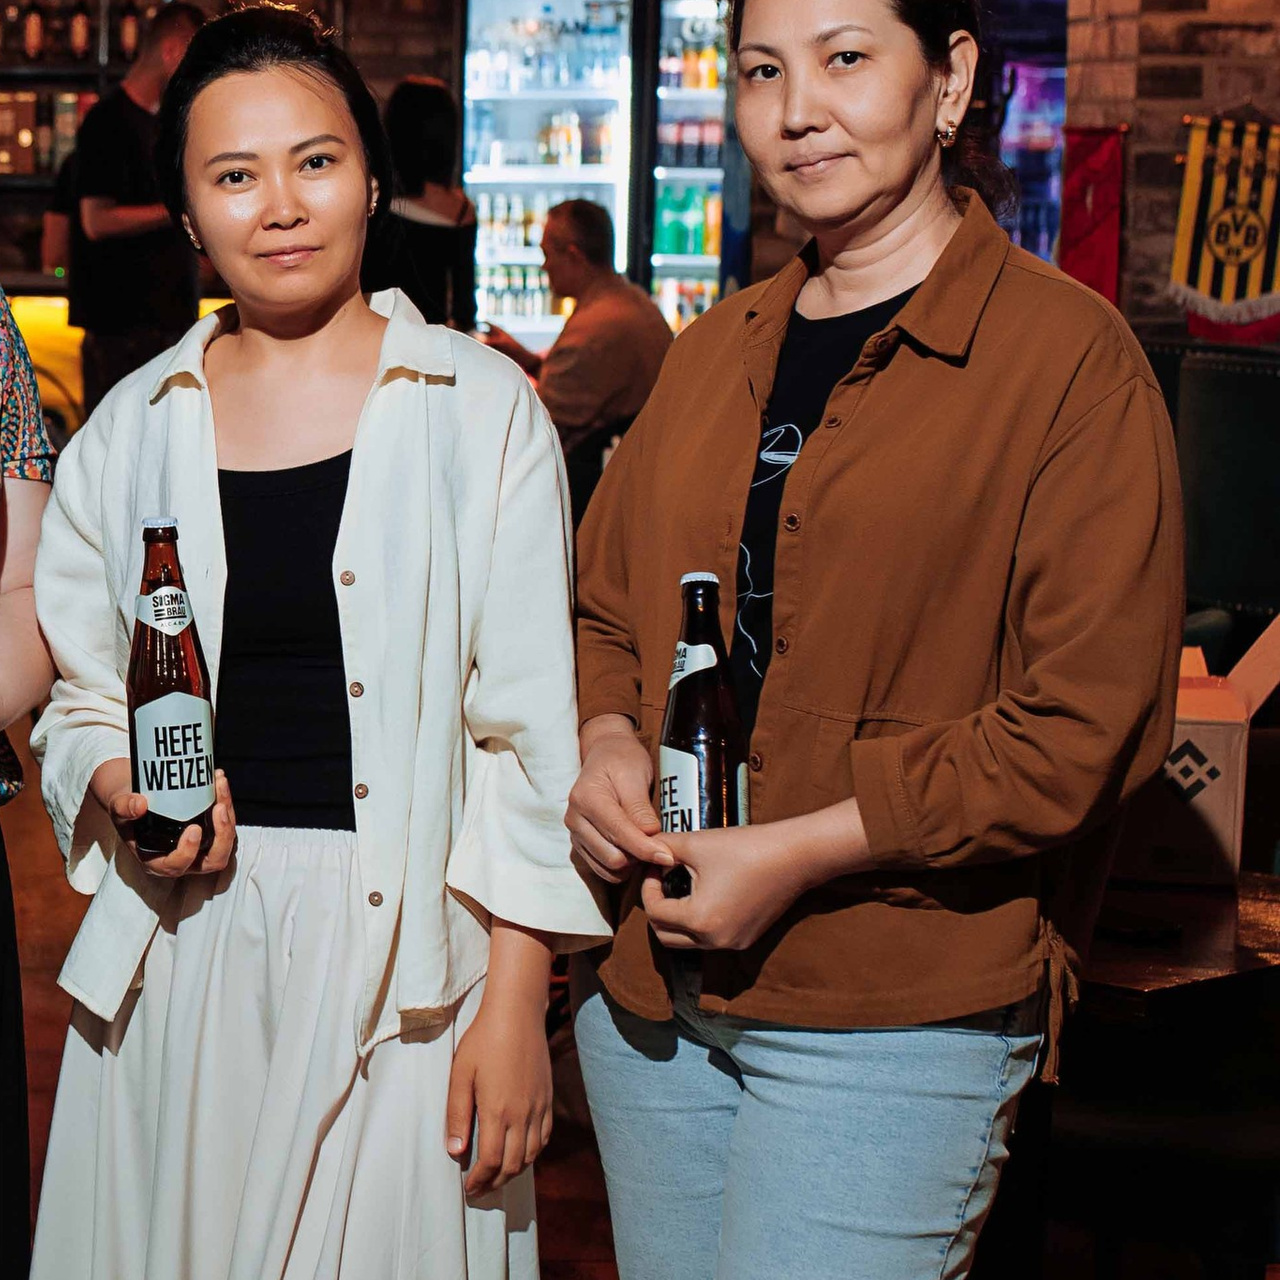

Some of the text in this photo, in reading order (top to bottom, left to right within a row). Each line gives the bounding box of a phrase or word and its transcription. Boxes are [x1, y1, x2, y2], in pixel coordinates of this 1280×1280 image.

[152, 593, 185, 608] SIGMA
[154, 722, 204, 757] HEFE
[142, 754, 213, 791] WEIZEN
